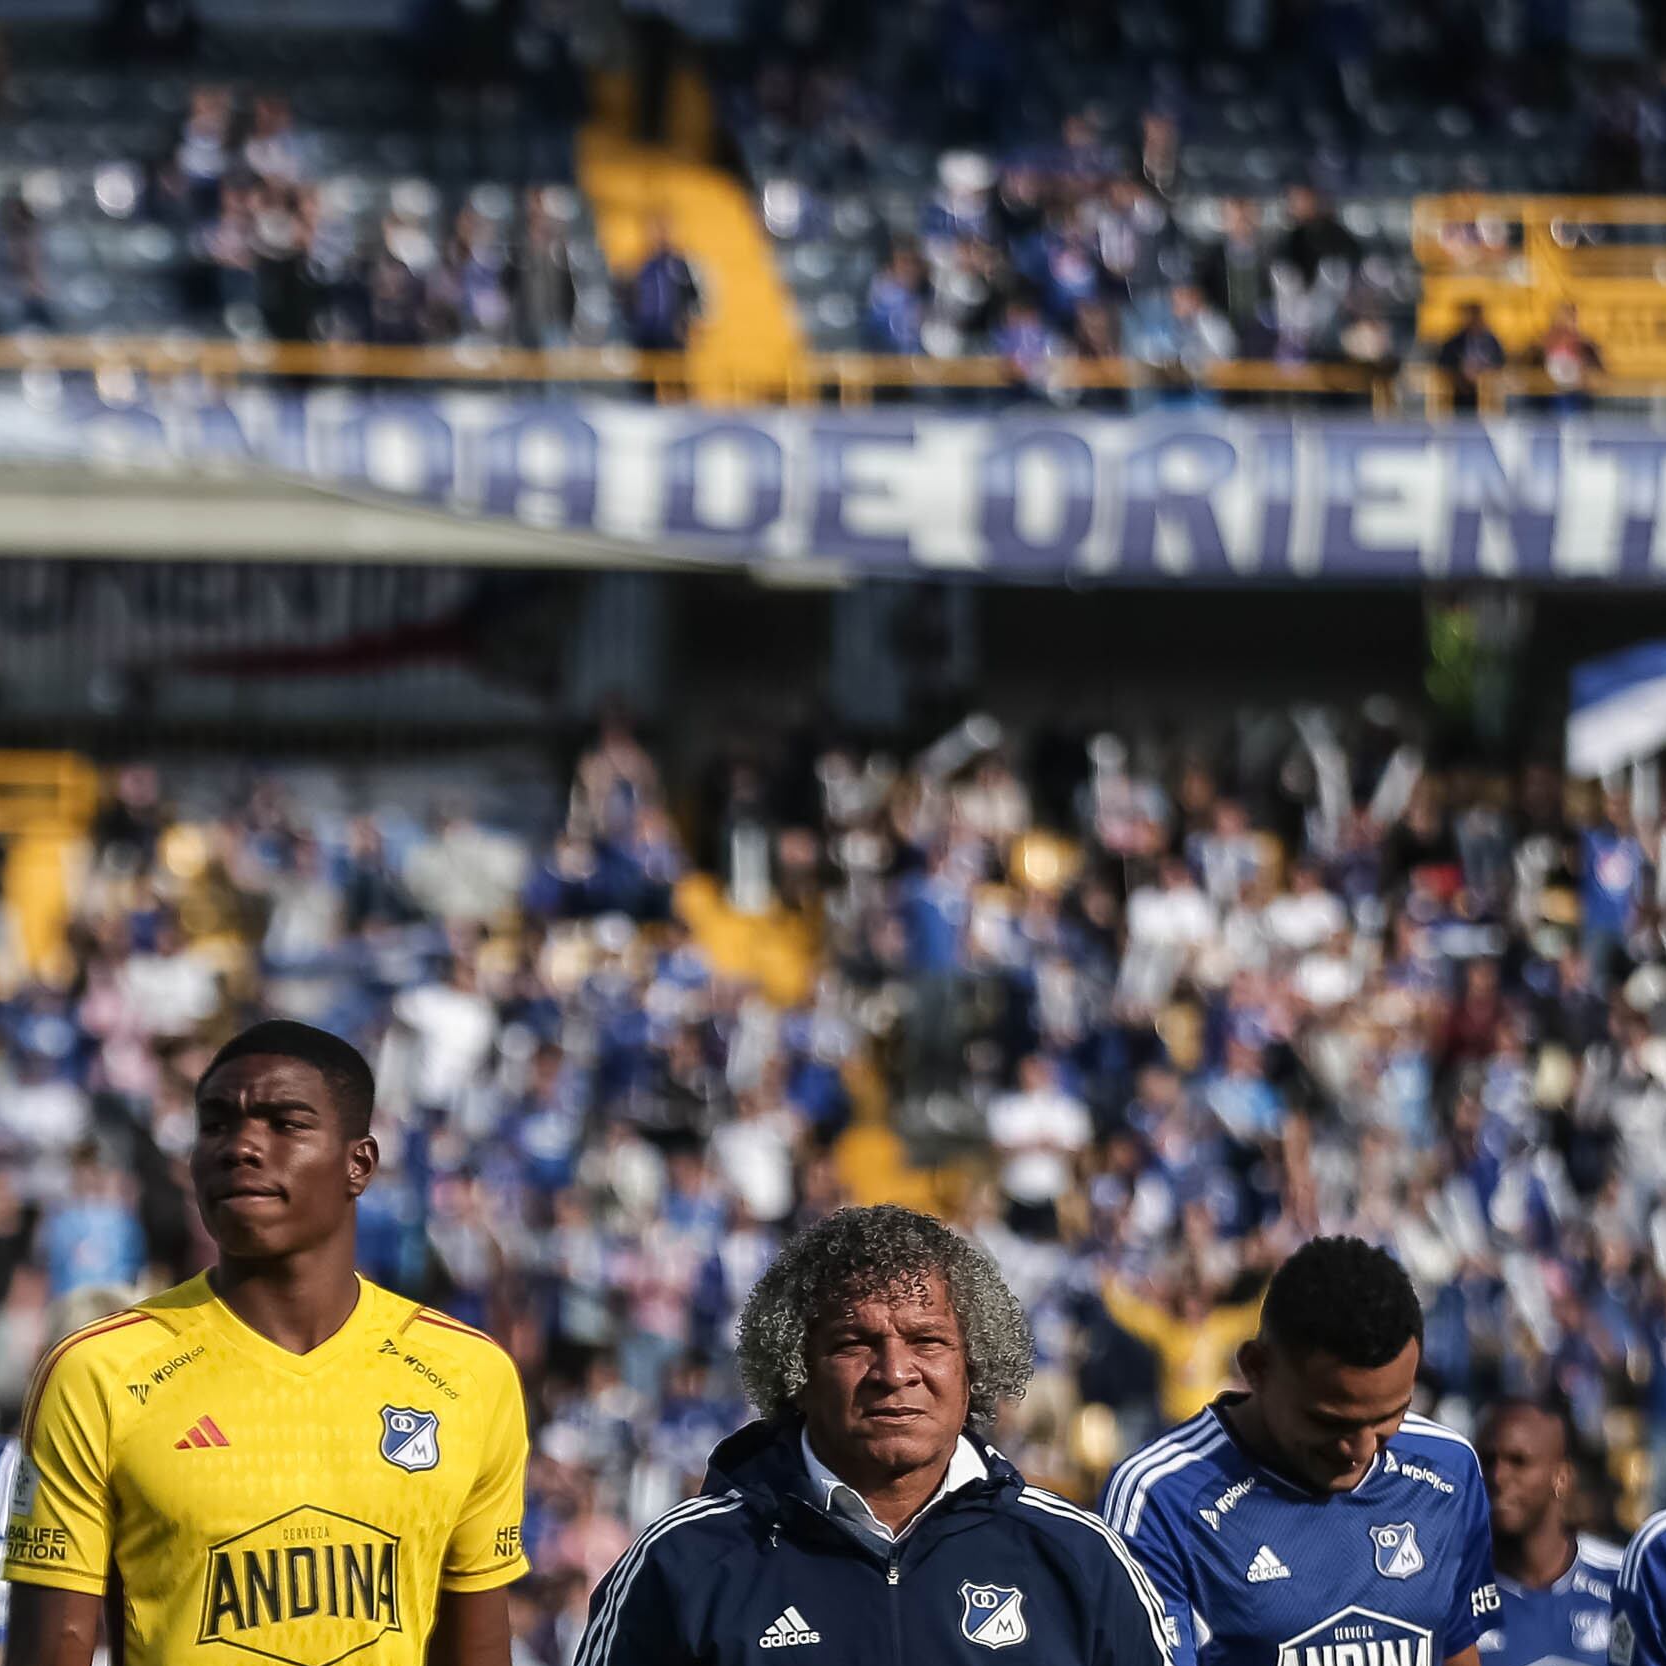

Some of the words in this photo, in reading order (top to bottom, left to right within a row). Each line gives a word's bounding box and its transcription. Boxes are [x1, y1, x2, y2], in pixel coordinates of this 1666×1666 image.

[283, 1526, 330, 1540] CERVEZA
[206, 1543, 396, 1637] ANDINA
[759, 1630, 820, 1648] adidas
